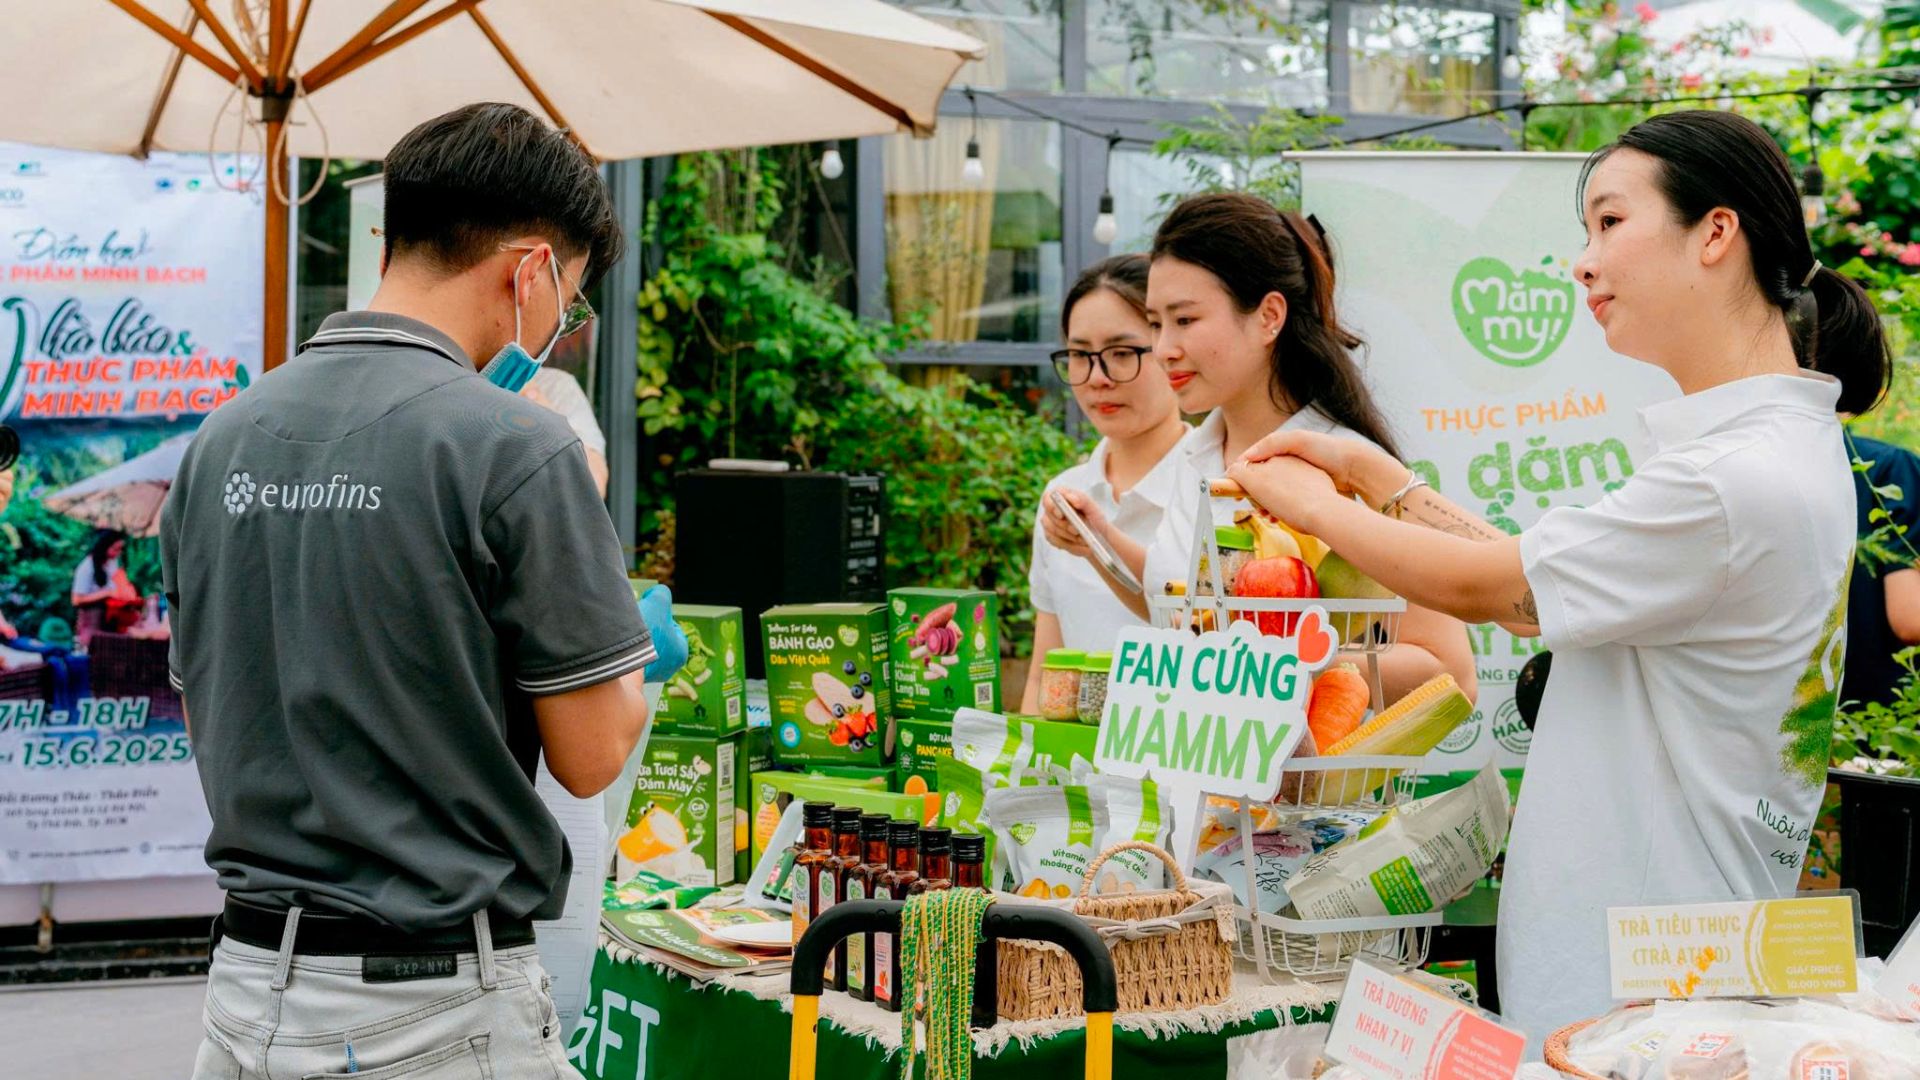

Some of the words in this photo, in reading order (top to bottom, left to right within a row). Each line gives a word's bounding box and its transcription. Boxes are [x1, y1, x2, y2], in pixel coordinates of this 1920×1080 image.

[170, 330, 194, 356] &
[26, 358, 124, 389] THỰC
[132, 348, 239, 383] PHẨM
[21, 390, 123, 417] MINH
[136, 386, 240, 421] BẠCH
[1421, 404, 1507, 436] THỰC
[1515, 386, 1608, 427] PHẨM
[1467, 436, 1634, 508] dặm
[260, 474, 382, 511] eurofins
[769, 634, 804, 650] BÁNH
[806, 636, 835, 653] GẠO
[1116, 641, 1184, 689] FAN
[1191, 636, 1300, 702] CỨNG
[79, 697, 149, 729] 18H
[22, 736, 191, 768] 15.6.2025
[1102, 693, 1292, 784] MĂMMY
[653, 762, 678, 777] Tươi
[1757, 798, 1798, 839] Nuôi
[1040, 858, 1073, 874] Khoáng
[1052, 849, 1086, 864] Vitamin
[1618, 914, 1650, 937] TRÀ
[1656, 912, 1692, 935] TIÊU
[1697, 914, 1741, 938] THỰC
[1632, 943, 1671, 966] (TRÀ
[1362, 977, 1384, 1007] TRÀ
[1385, 990, 1429, 1027] DƯỠNG
[1390, 1027, 1400, 1047] 7
